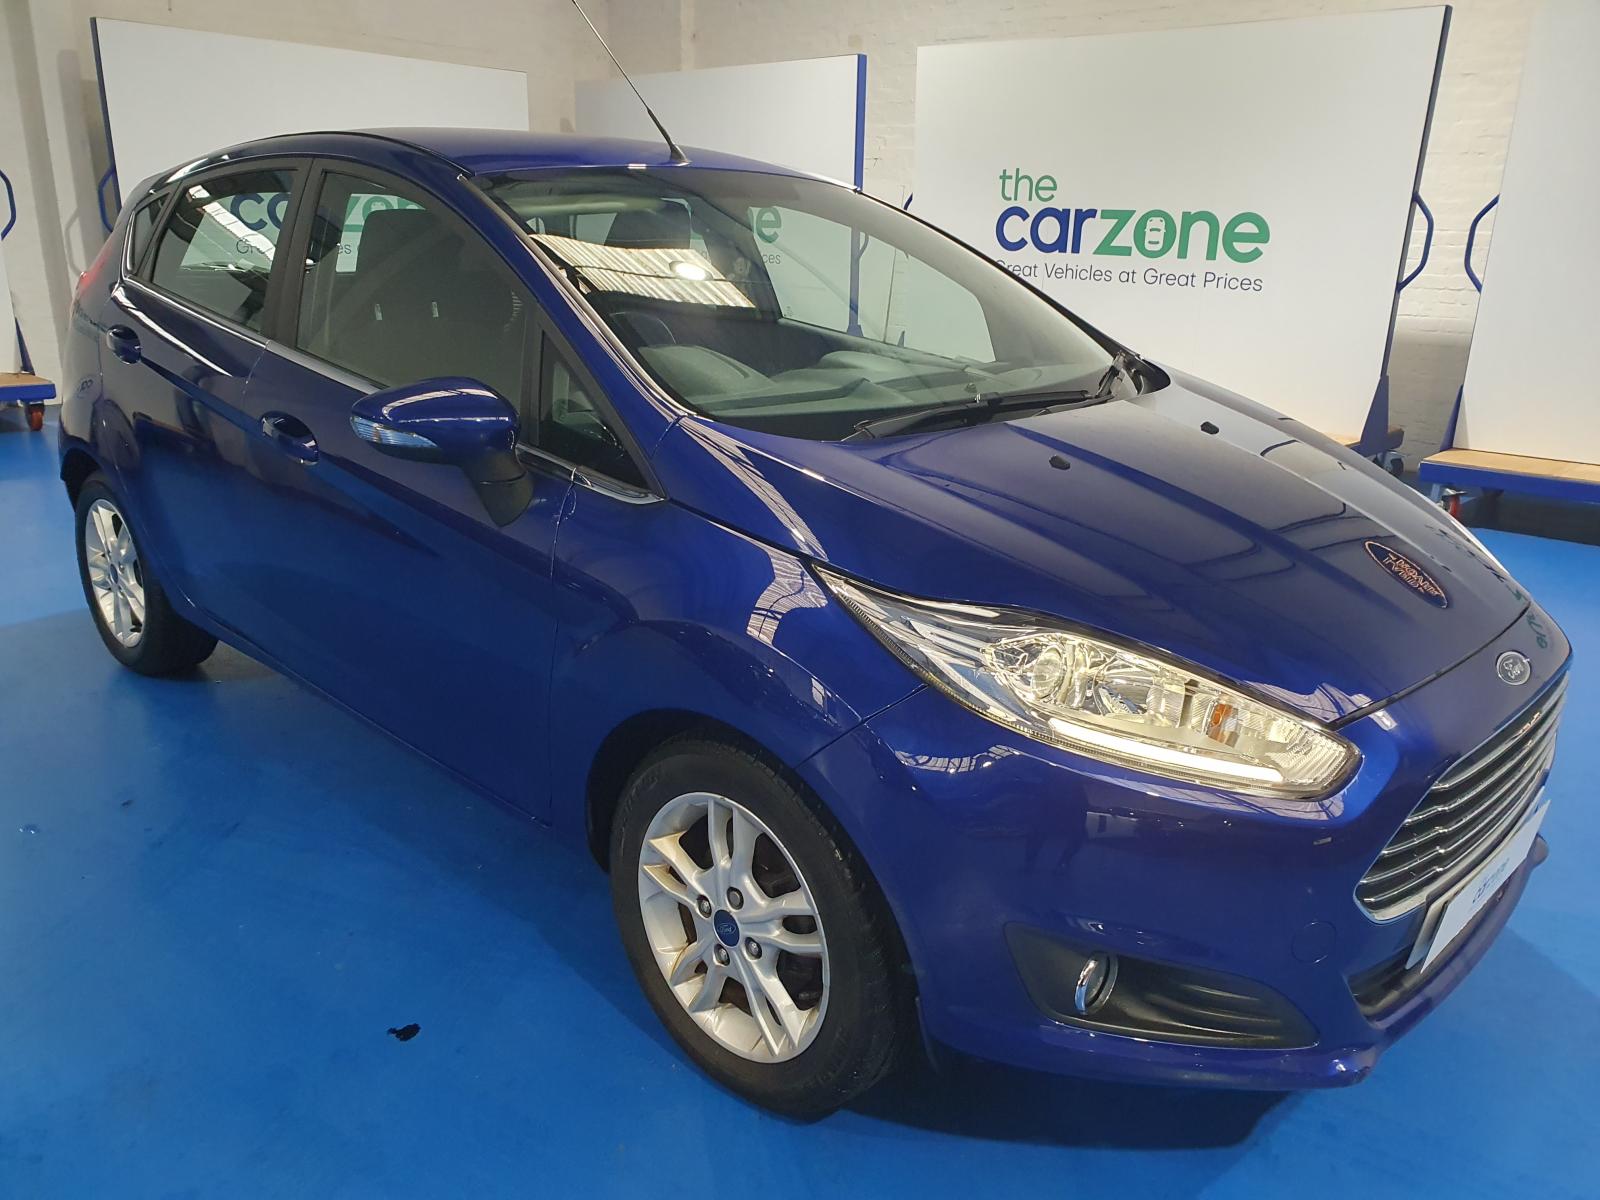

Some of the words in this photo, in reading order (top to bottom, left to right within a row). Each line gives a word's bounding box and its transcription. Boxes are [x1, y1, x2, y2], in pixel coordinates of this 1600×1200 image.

[999, 168, 1058, 202] the
[995, 205, 1271, 264] carzone
[1044, 263, 1113, 282] Vehicles
[1118, 269, 1137, 284] at
[1143, 267, 1196, 288] Great
[1203, 272, 1264, 292] Prices
